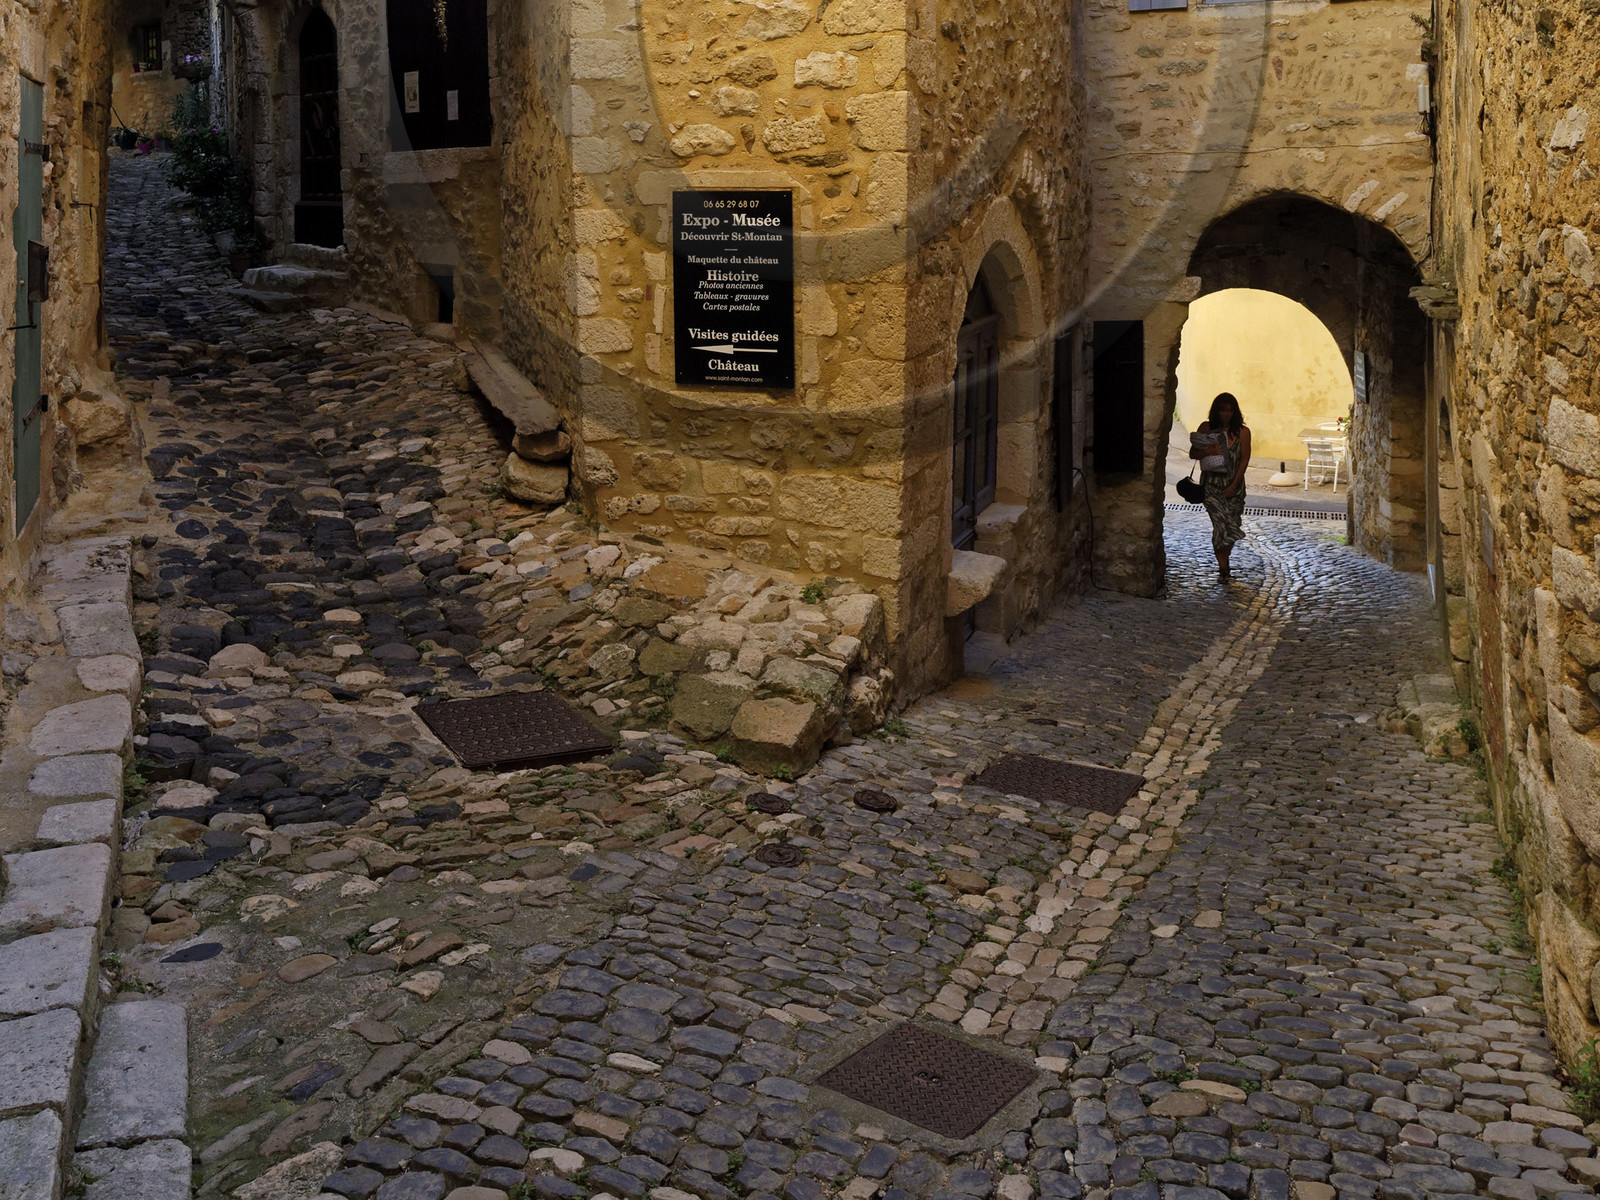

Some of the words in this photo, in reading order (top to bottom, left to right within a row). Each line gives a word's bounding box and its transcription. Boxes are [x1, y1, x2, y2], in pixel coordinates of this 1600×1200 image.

[703, 200, 713, 208] 06
[715, 200, 725, 208] 65
[726, 200, 736, 208] 29
[738, 200, 748, 208] 68
[749, 200, 760, 208] 07
[682, 213, 720, 229] Expo
[732, 213, 781, 226] Musée
[680, 232, 729, 241] Découvrir
[731, 232, 783, 241] St-Montan
[687, 255, 728, 265] Maquette
[730, 256, 742, 264] du
[743, 256, 779, 264] château
[707, 270, 759, 282] Histoire
[698, 281, 724, 289] Photos
[726, 282, 764, 290] anciennes
[694, 291, 729, 300] Tableaux
[703, 302, 728, 310] Cartes
[728, 303, 760, 312] postales
[688, 328, 729, 340] Visites
[731, 330, 779, 342] guidées
[708, 359, 760, 372] Château
